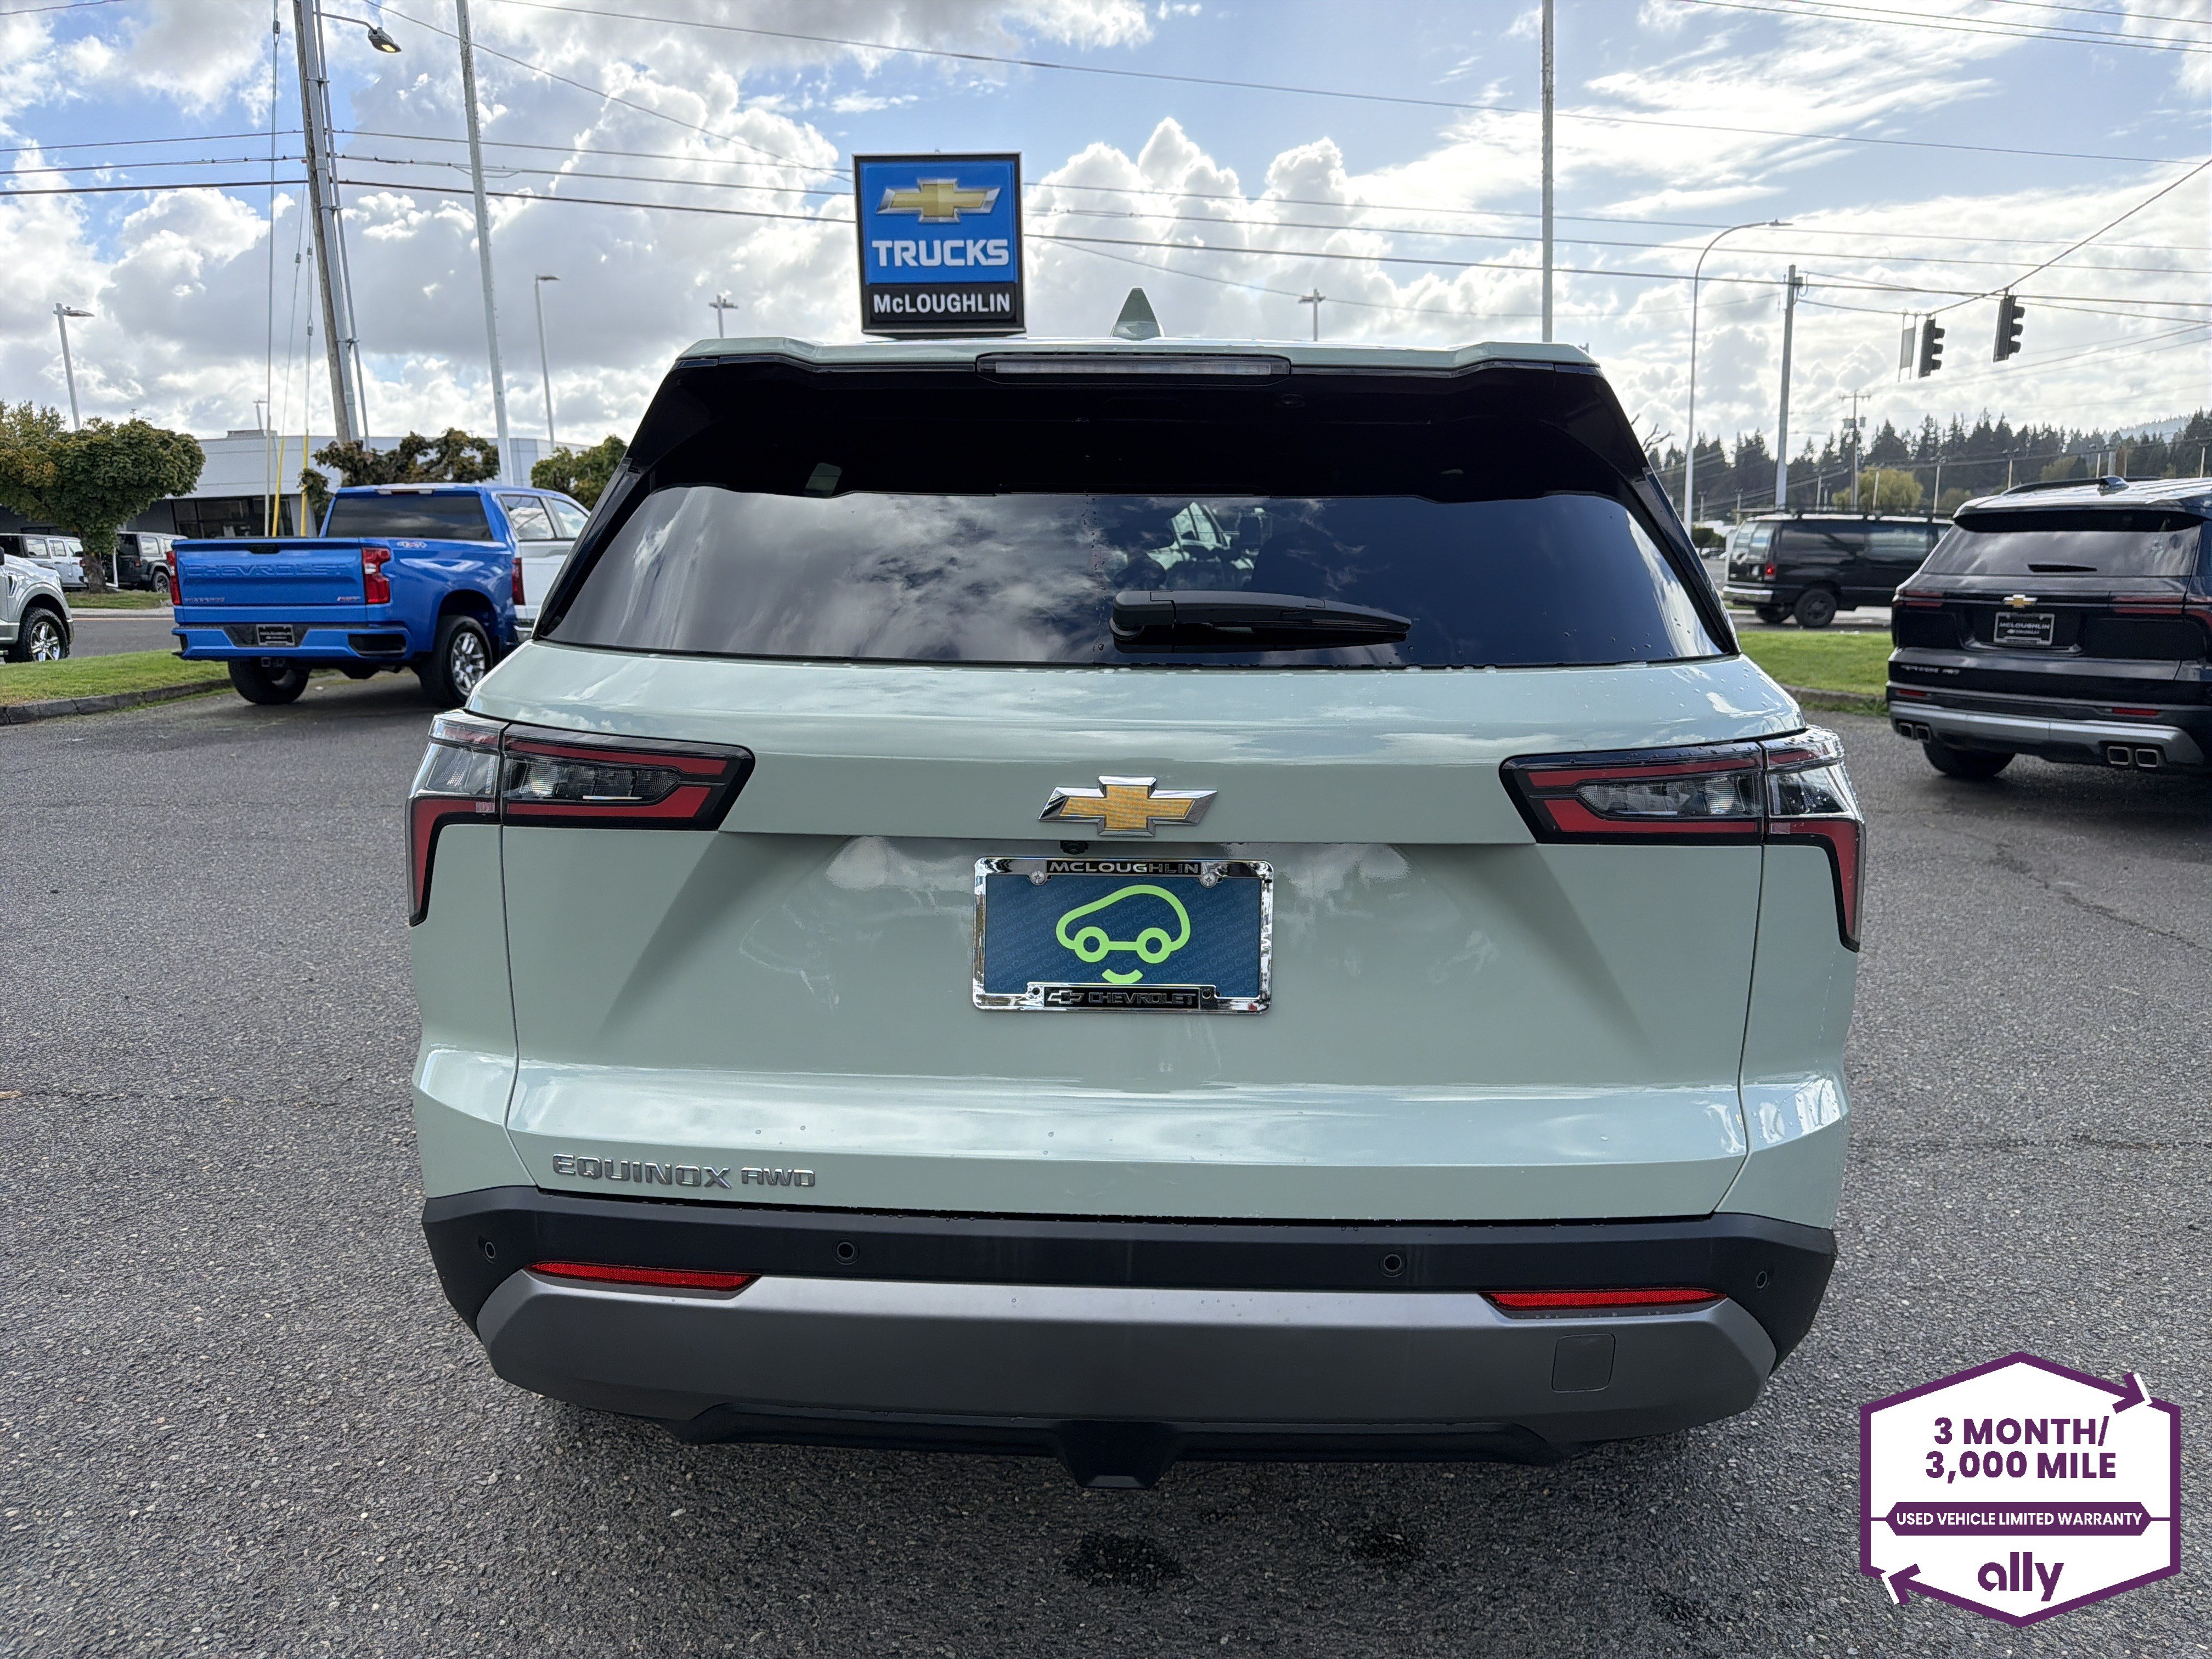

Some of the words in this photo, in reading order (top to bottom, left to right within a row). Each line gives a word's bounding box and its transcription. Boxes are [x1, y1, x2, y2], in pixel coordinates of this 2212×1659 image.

[872, 239, 1009, 267] TRUCKS
[873, 292, 1010, 313] McLOUGHLIN
[186, 563, 346, 576] CHEVROLET
[1049, 862, 1198, 873] MCLOUGHLIN
[1088, 992, 1196, 1005] CHEVROLET
[552, 1153, 731, 1188] EQUINOX
[741, 1166, 815, 1187] AWD
